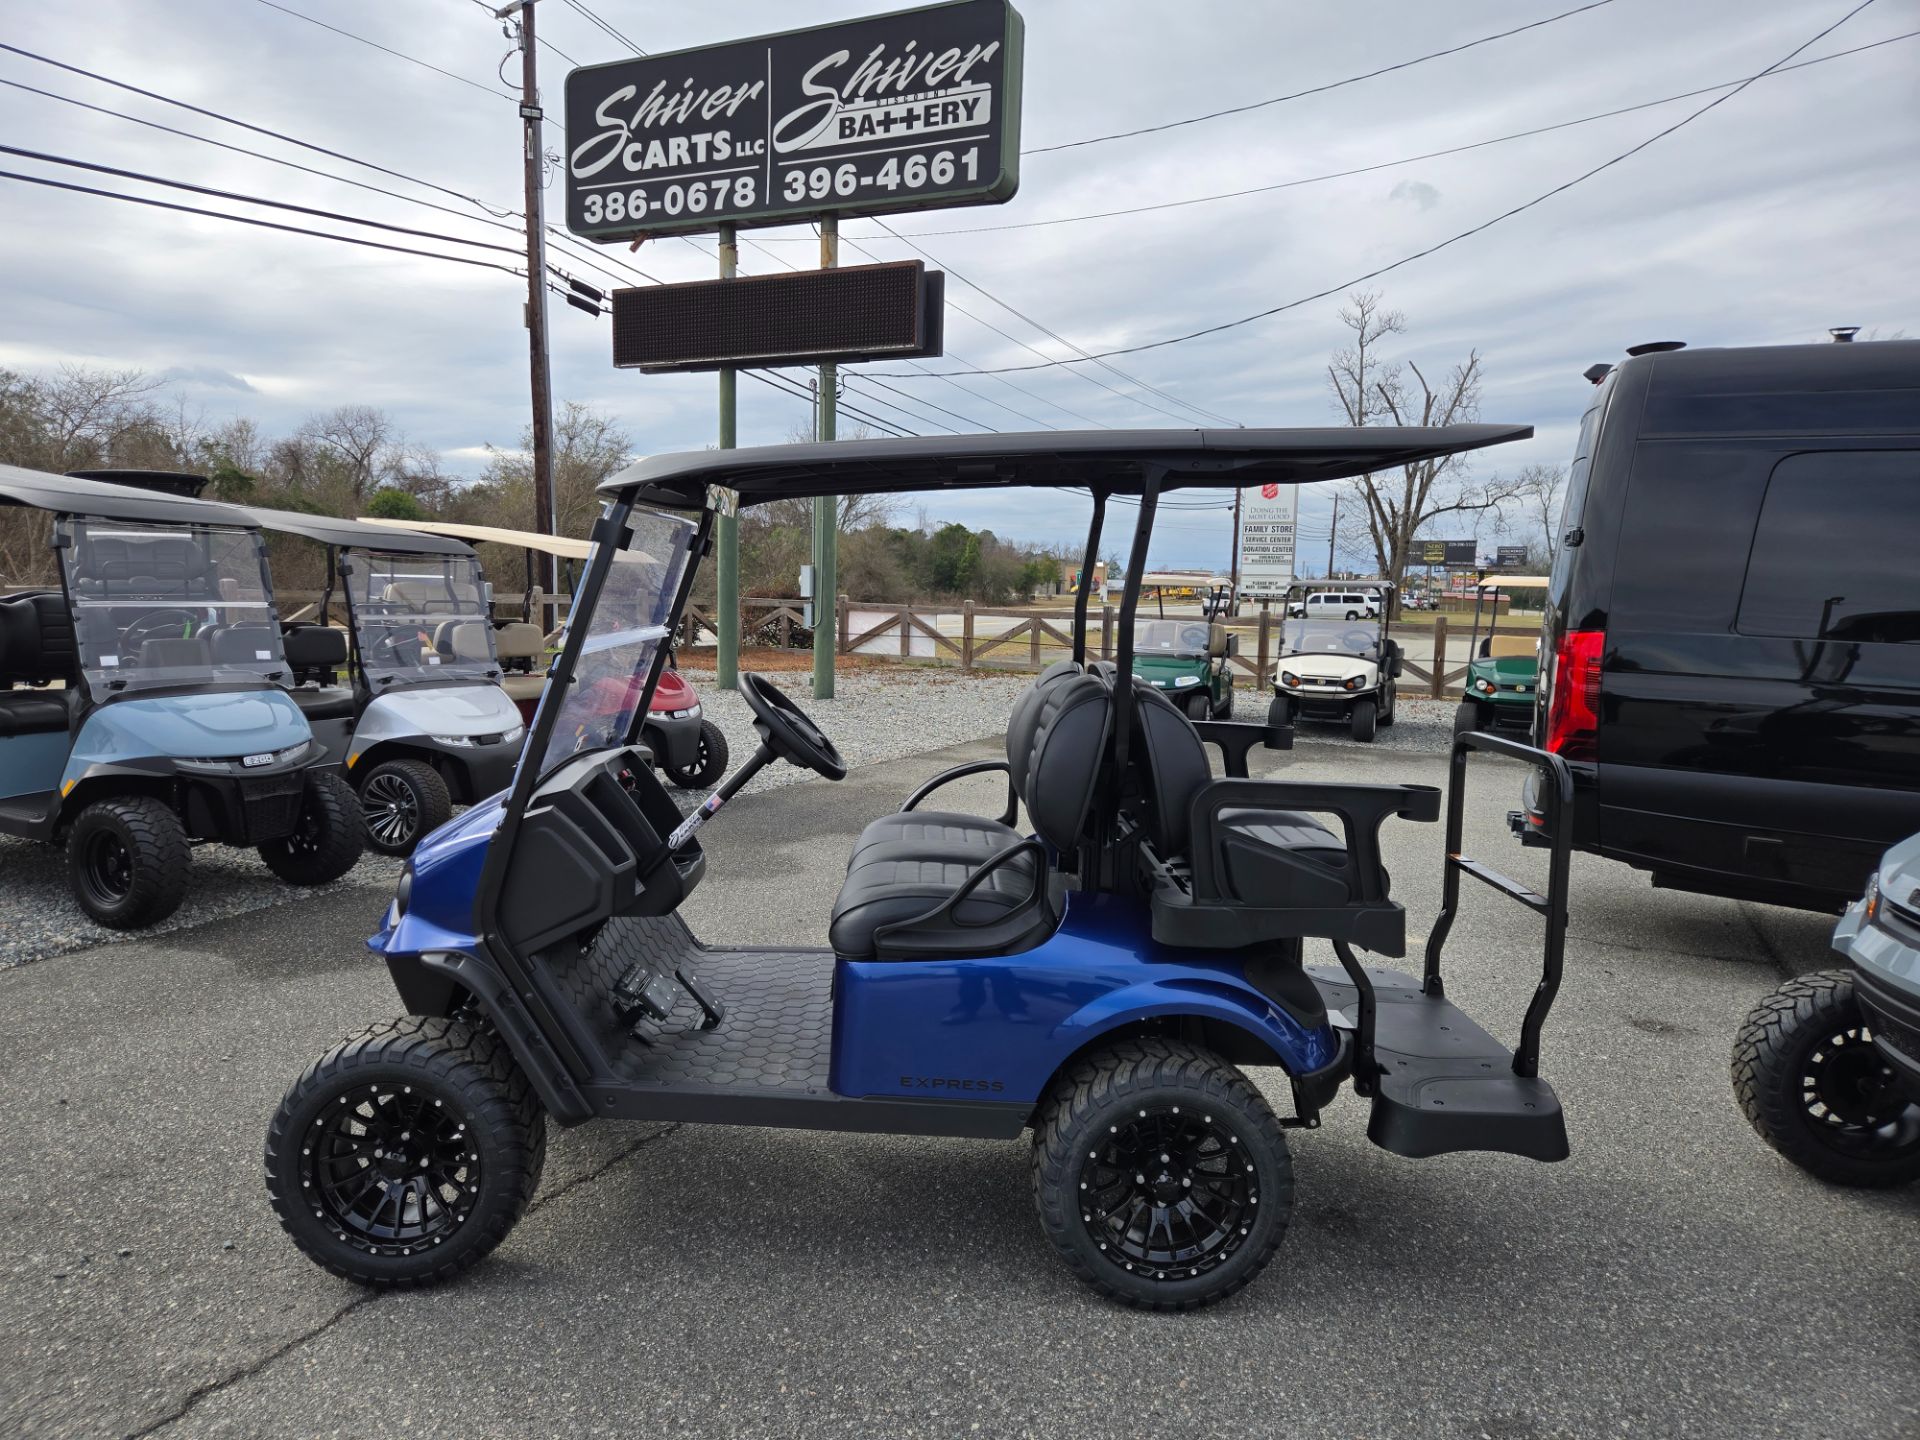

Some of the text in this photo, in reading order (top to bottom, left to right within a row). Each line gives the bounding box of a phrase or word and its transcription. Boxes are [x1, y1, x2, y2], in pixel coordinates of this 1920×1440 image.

[773, 40, 1000, 153] Shiver
[876, 89, 948, 106] DISCOUNT
[571, 77, 765, 179] Shiver
[622, 130, 765, 172] CARTS LLC
[783, 146, 979, 202] 396-4661
[583, 176, 756, 224] 386-0678
[1244, 525, 1293, 533] FAMILY STORE
[900, 1076, 1004, 1092] EXPRESS
